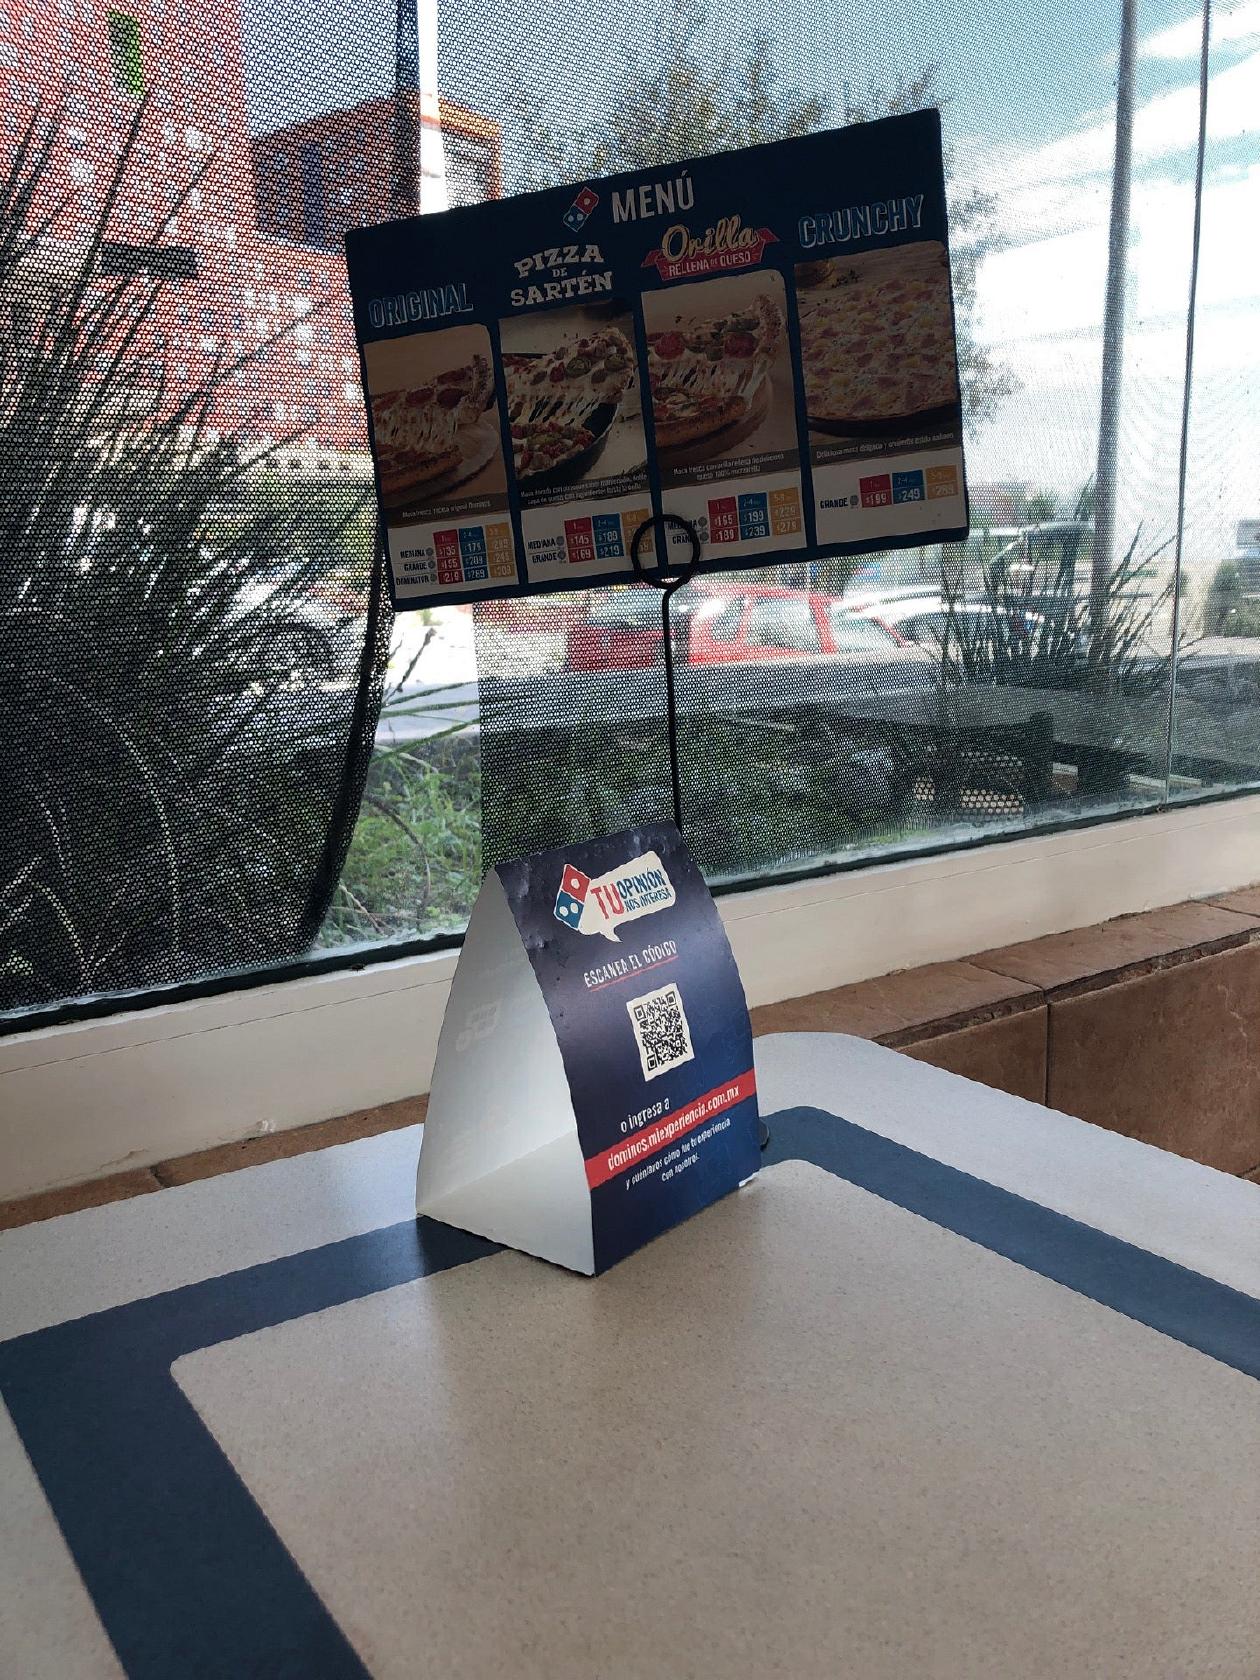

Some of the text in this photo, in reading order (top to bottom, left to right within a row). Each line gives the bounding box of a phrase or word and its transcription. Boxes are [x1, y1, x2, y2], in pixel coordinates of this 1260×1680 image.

[611, 170, 695, 224] MENÚ
[661, 214, 761, 262] Orilla
[798, 194, 924, 248] CRUNCHY
[514, 244, 604, 279] PIZZA
[552, 267, 568, 278] DE
[668, 260, 710, 278] RELLENA
[720, 251, 751, 269] QUESO
[368, 282, 474, 328] ORIGINAL
[510, 269, 613, 307] SARTÉN
[820, 497, 848, 509] GRANDE
[532, 552, 557, 564] GRANDE
[590, 882, 625, 920] TU
[616, 868, 667, 900] OPINIÓN
[624, 888, 673, 912] NOS INTERESA
[583, 940, 677, 988] ESCANEA EL CÓDIGO
[607, 1085, 740, 1172] dominos.miexperiencia.com.mx
[620, 1097, 670, 1133] o ingresa a
[697, 1118, 731, 1144] experiencia
